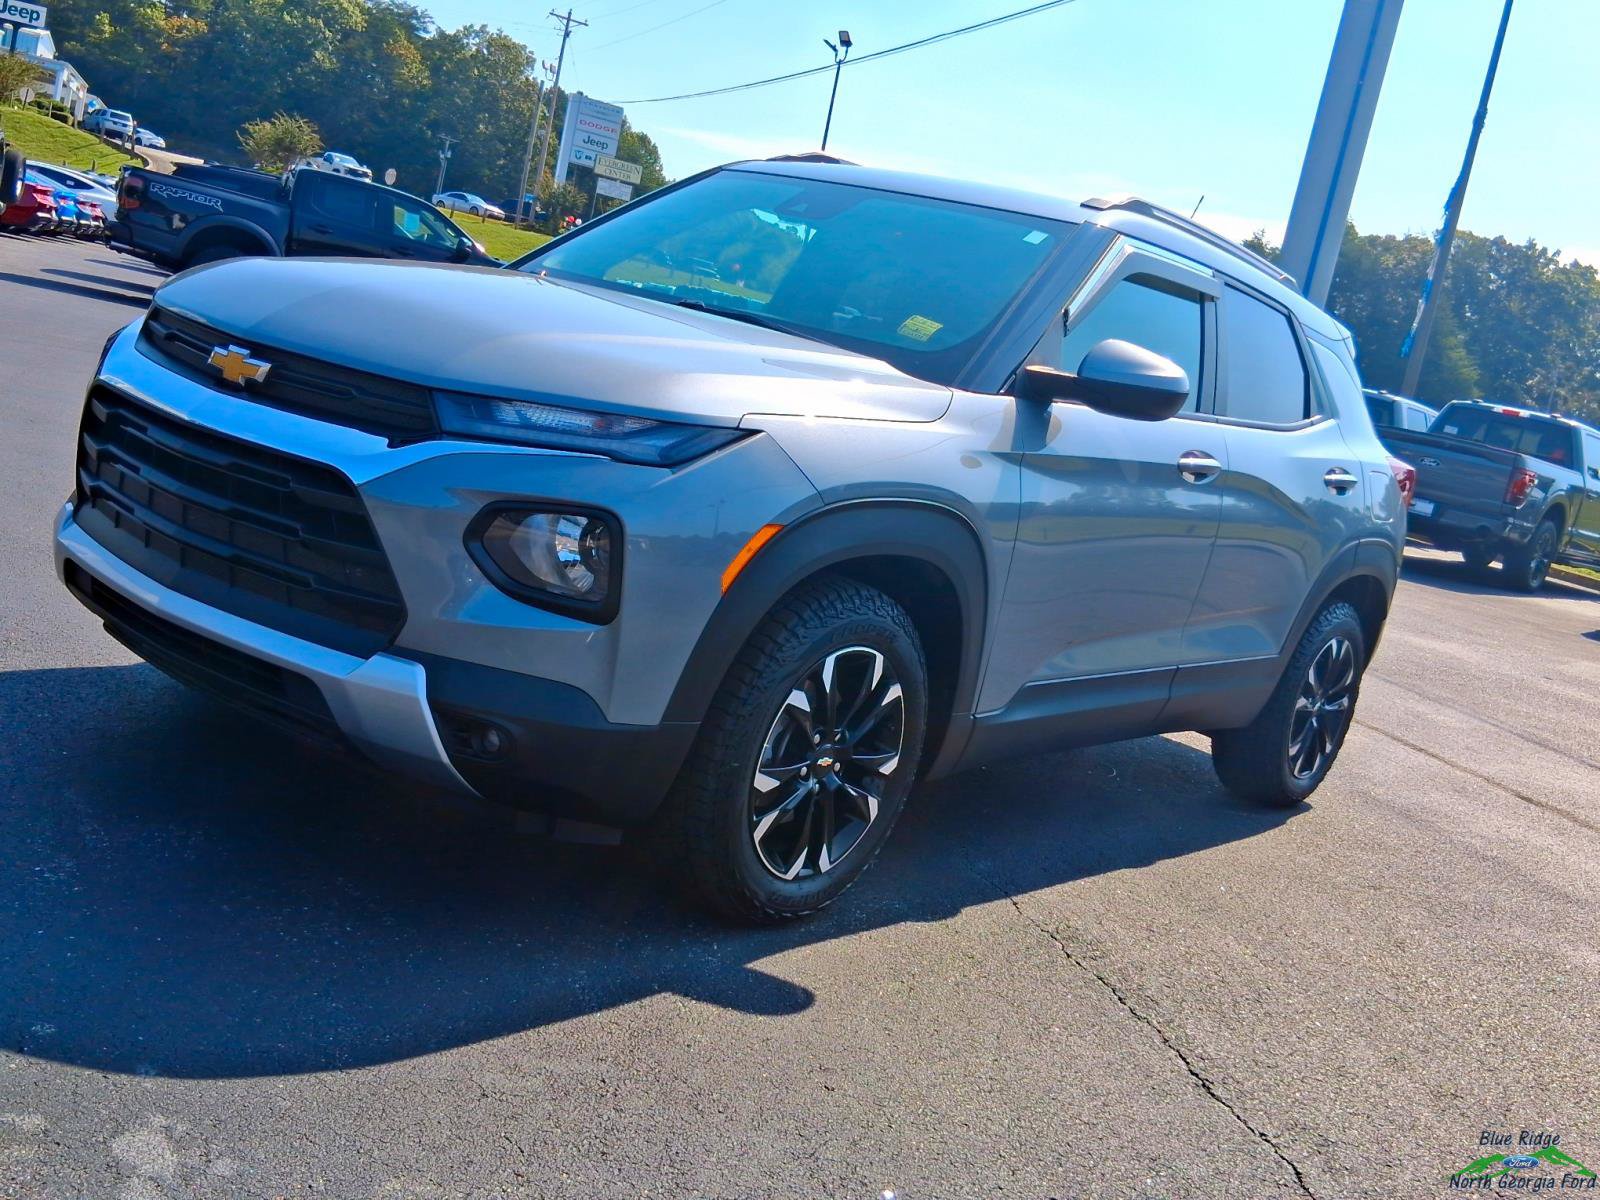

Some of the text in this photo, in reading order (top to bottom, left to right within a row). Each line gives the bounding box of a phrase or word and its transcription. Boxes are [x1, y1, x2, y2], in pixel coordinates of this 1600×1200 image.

[0, 0, 41, 23] Jeep
[579, 119, 617, 133] DODGE
[583, 136, 609, 150] Jeep
[150, 183, 224, 213] RAPTOR
